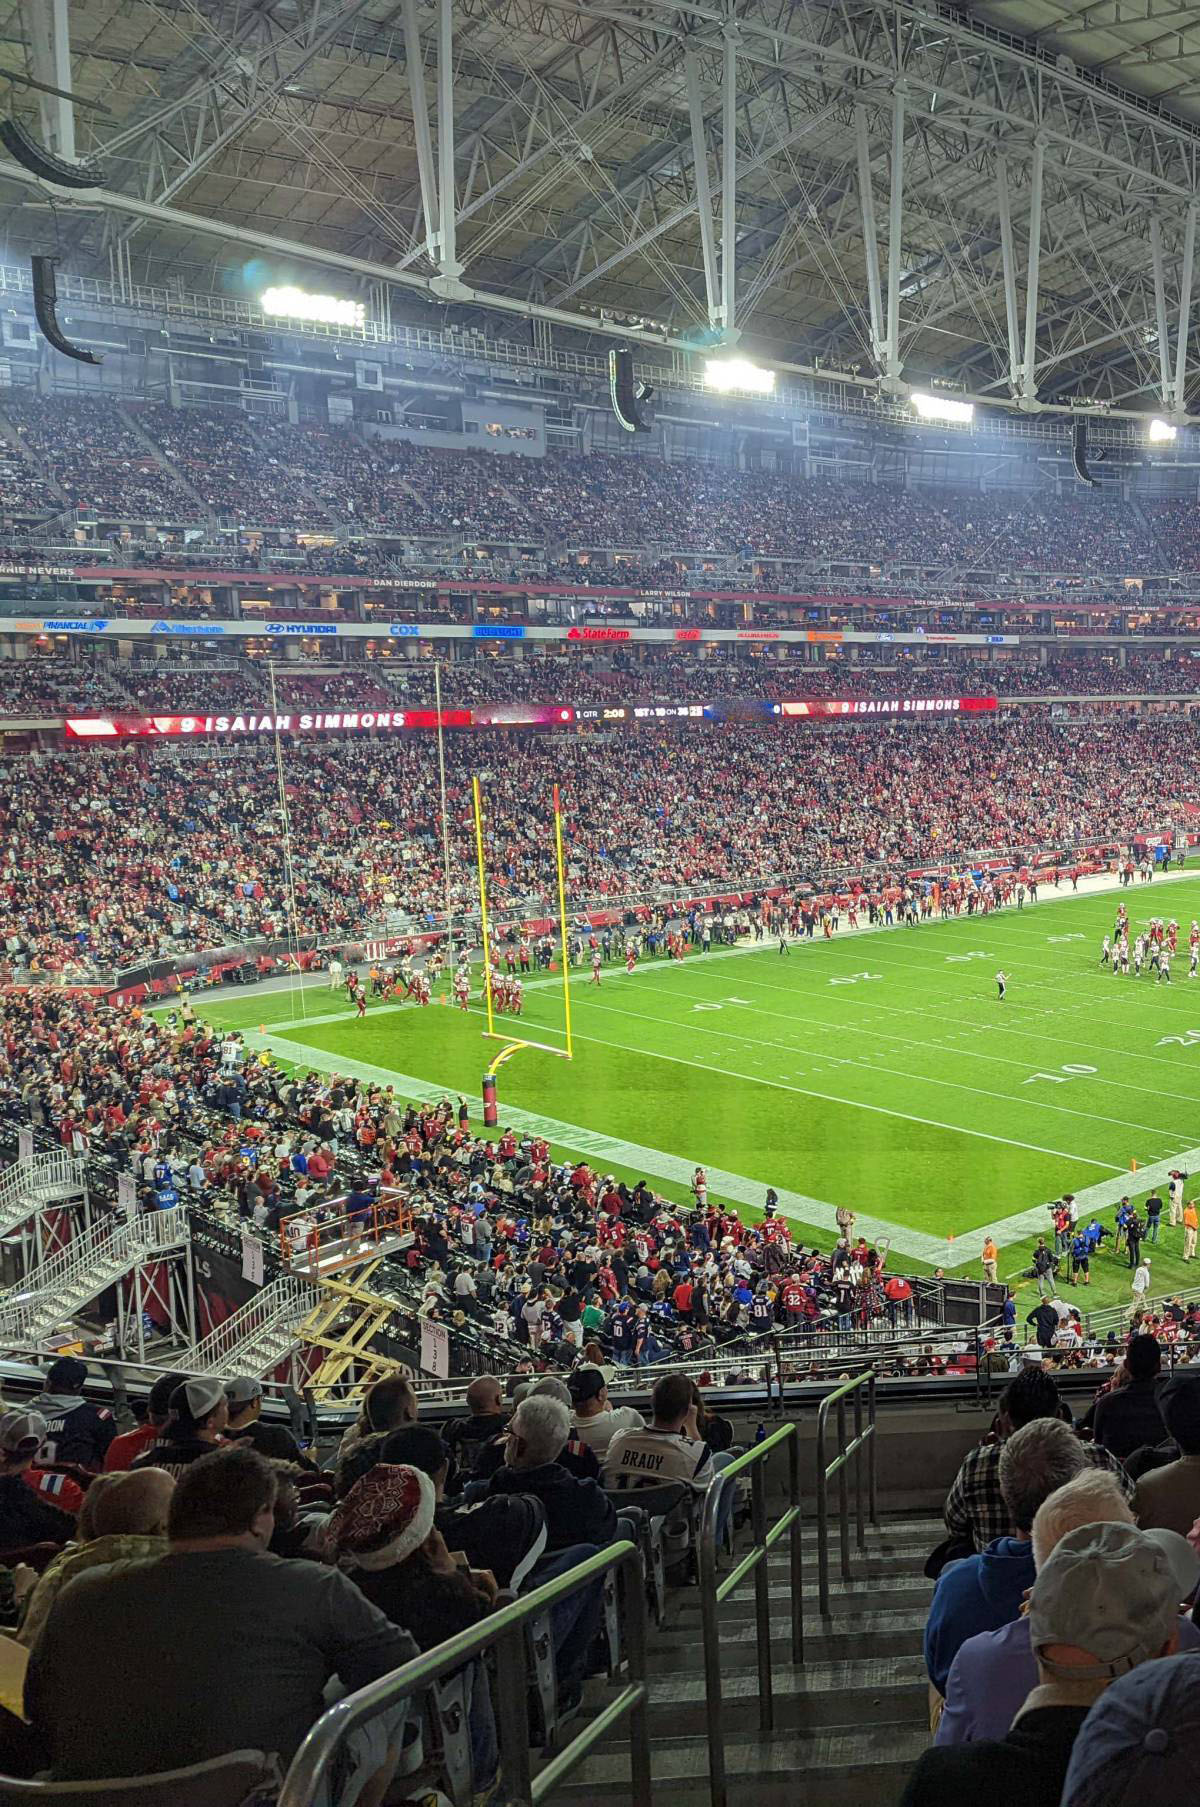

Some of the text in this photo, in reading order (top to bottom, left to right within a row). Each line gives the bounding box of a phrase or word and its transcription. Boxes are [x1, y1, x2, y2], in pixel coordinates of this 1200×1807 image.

[29, 566, 75, 576] NEVERS
[373, 578, 393, 587] DAN
[663, 590, 691, 598] WILSON
[286, 624, 337, 634] HYUNDAI
[389, 625, 420, 636] COX
[854, 701, 899, 712] ISAIAH
[903, 700, 961, 711] SIMMONS
[181, 713, 405, 732] 9 ISAIAH SIMMONS
[1029, 1062, 1099, 1085] 10
[787, 1294, 801, 1306] 32
[754, 1305, 768, 1318] 81
[423, 1321, 446, 1339] SECTION
[613, 1325, 623, 1337] 10
[620, 1450, 664, 1471] BRADY
